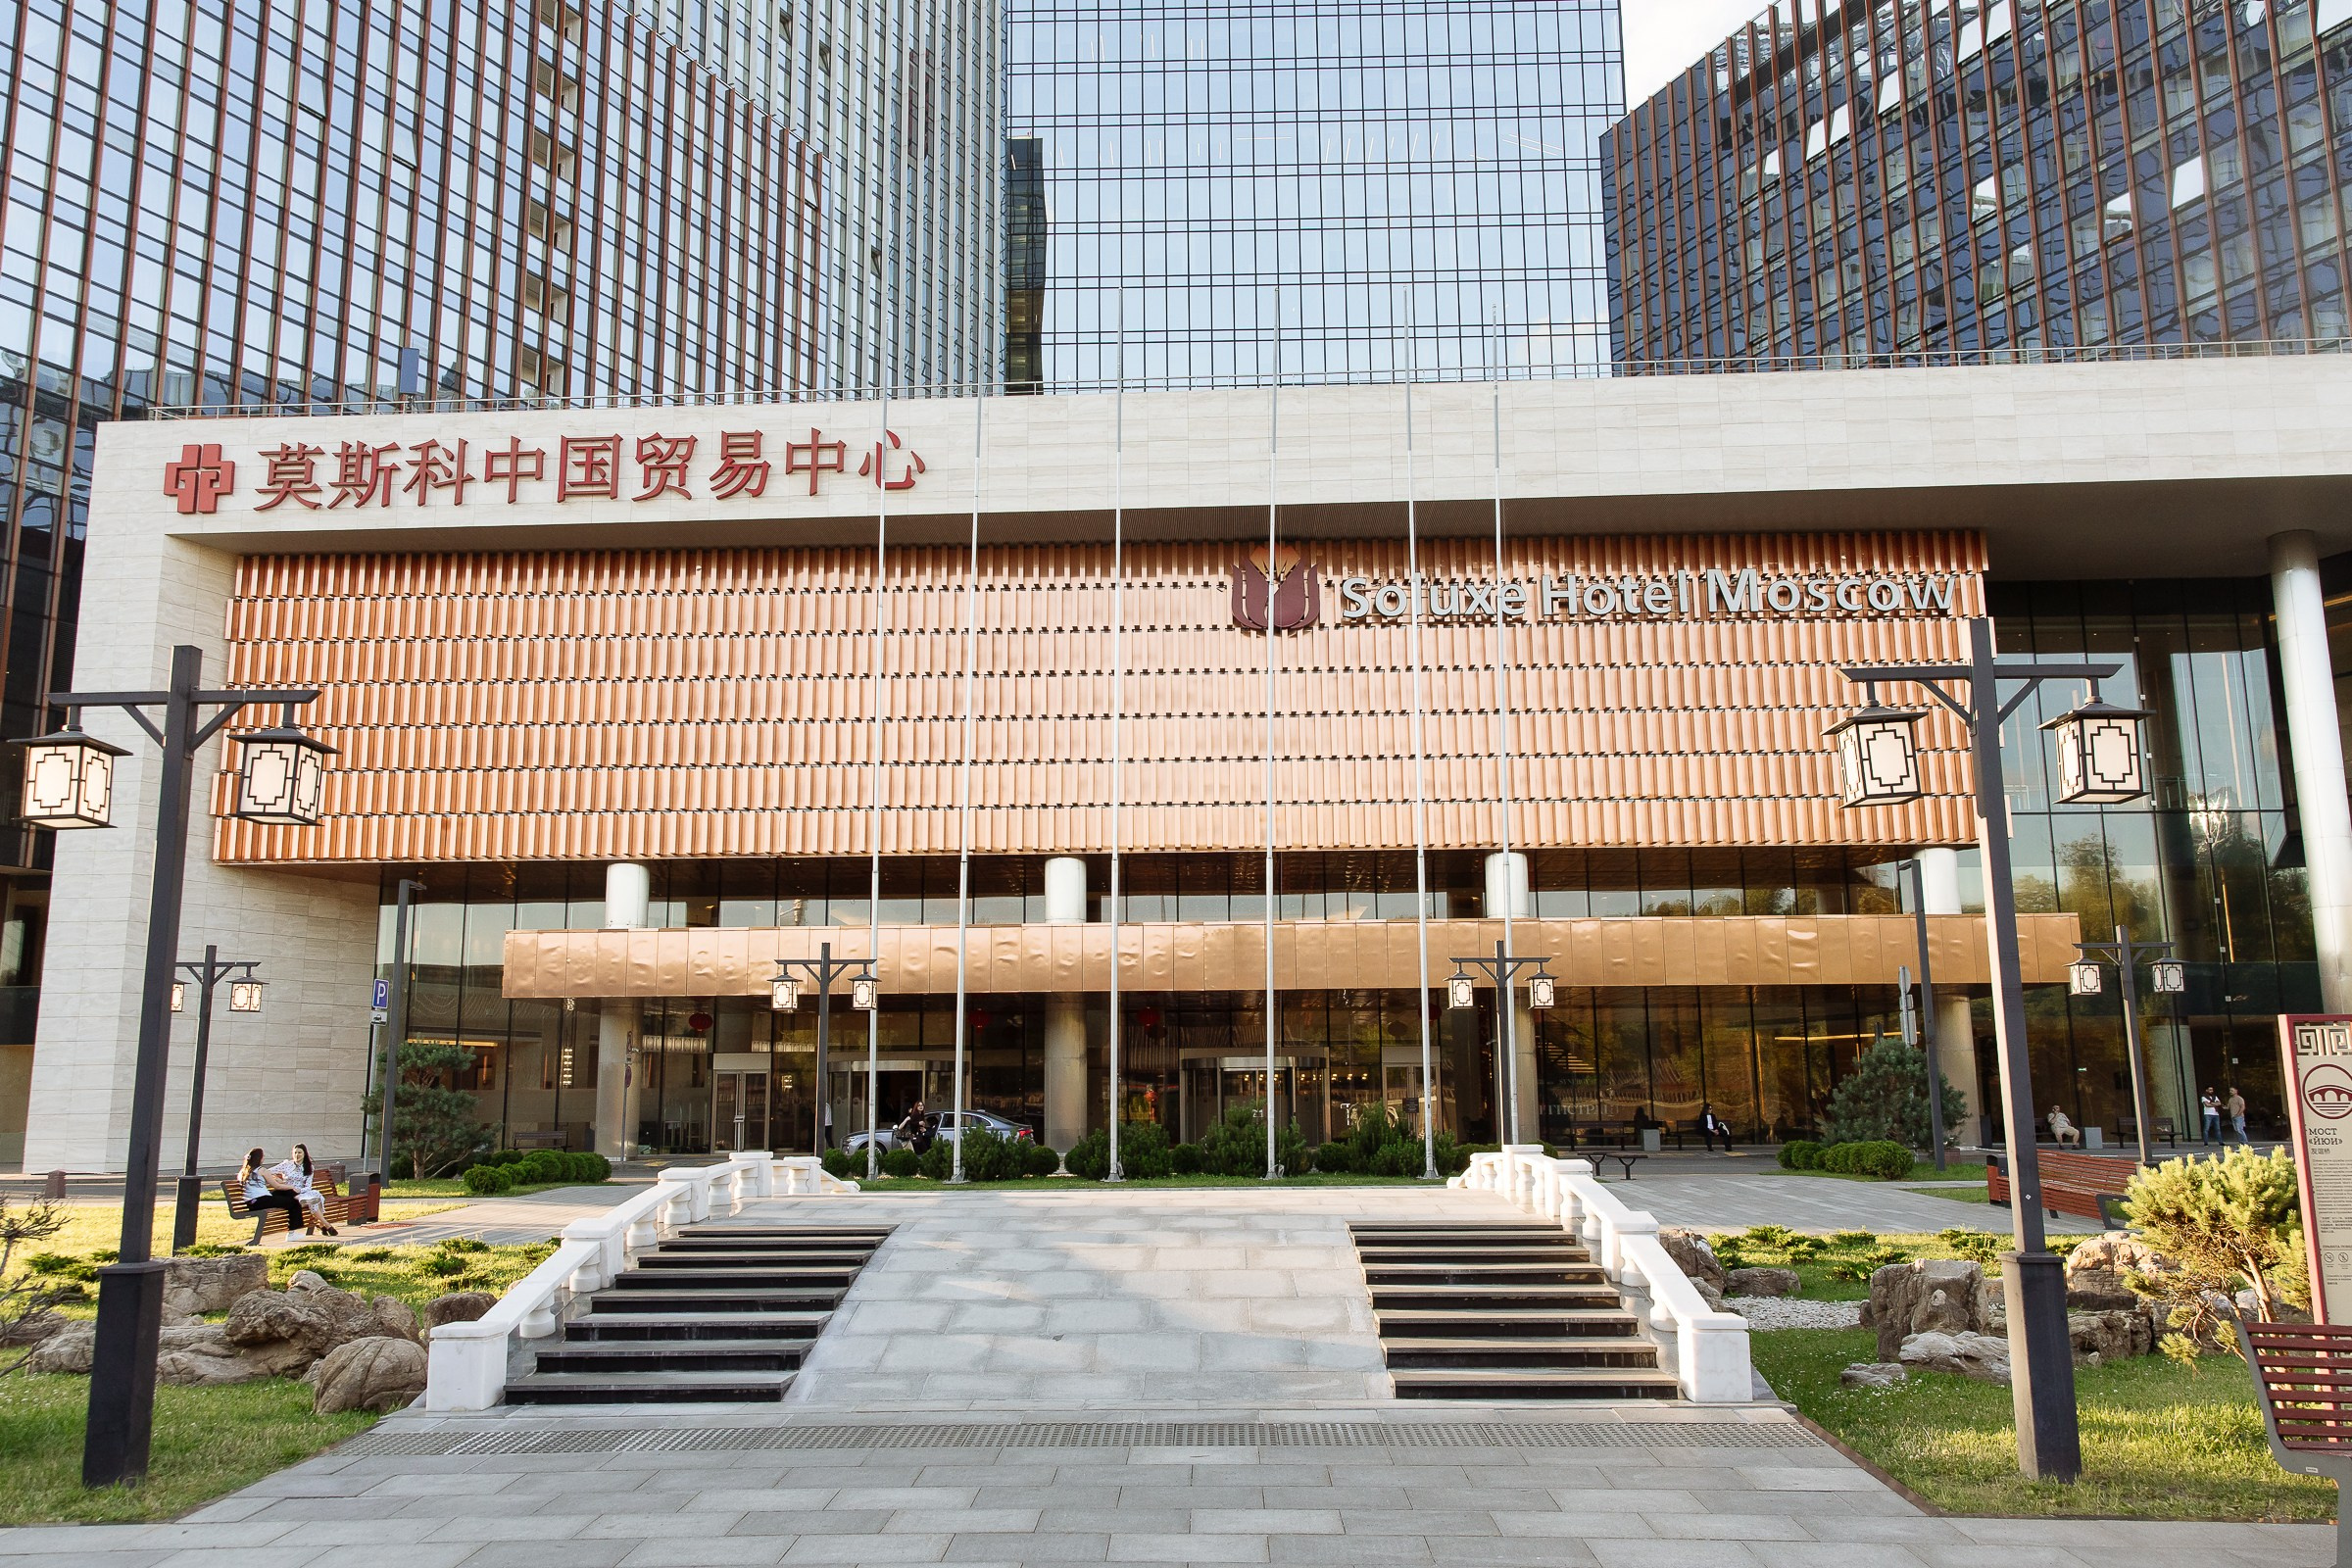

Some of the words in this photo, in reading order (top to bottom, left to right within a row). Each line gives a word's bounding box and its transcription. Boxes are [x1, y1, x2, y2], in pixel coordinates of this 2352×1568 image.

[253, 427, 926, 511] 莫斯科中国贸易中心
[1342, 571, 1527, 618] Soluxe
[1542, 568, 1690, 616] Hotel
[1706, 567, 1956, 613] Moscow
[377, 983, 386, 1004] P
[2308, 1127, 2337, 1136] МОСТ
[2308, 1136, 2343, 1146] «ЙЮИ»
